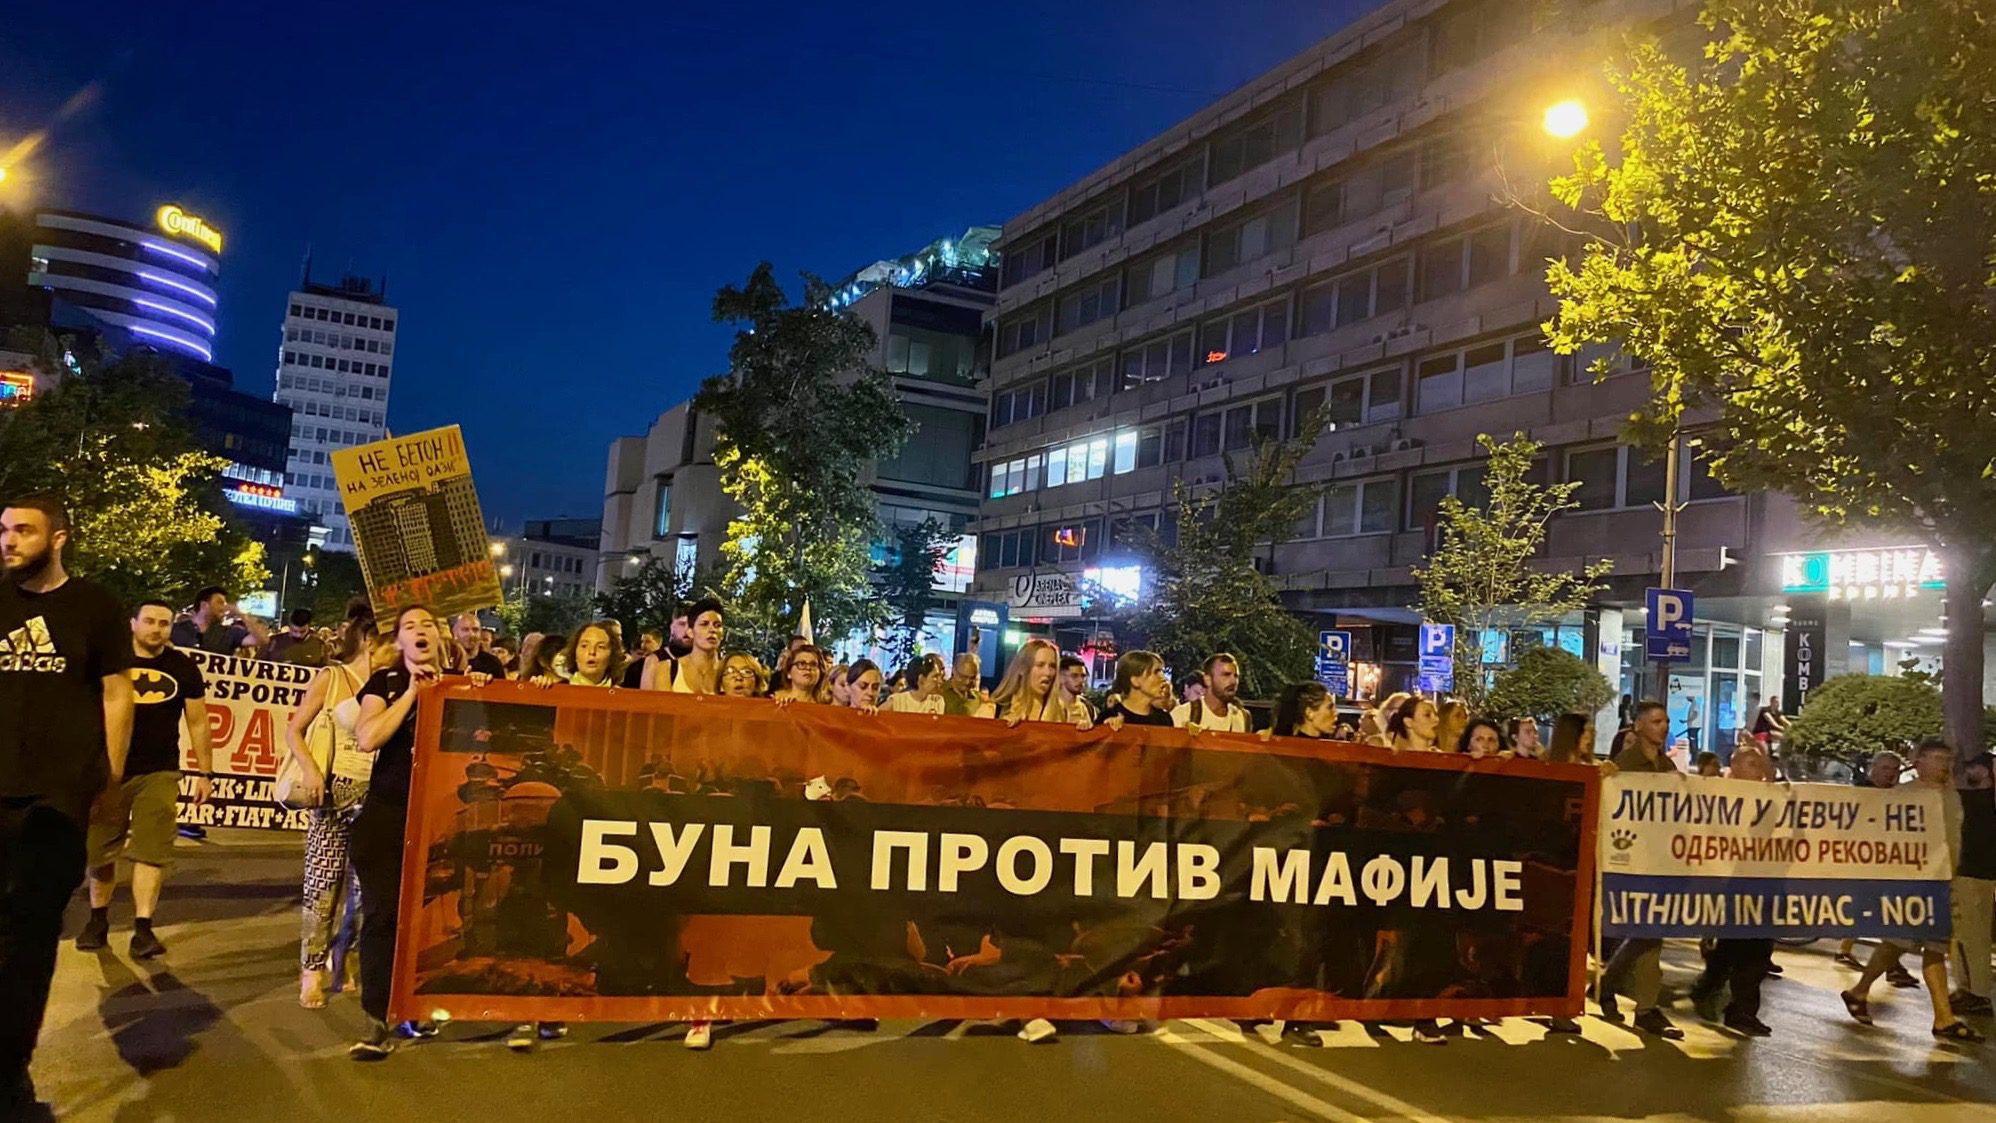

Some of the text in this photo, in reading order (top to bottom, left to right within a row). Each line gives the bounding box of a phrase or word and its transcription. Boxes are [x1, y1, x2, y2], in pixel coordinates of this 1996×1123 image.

[359, 450, 389, 474] НЕ
[347, 481, 366, 494] НА
[370, 469, 420, 488] ЗЕЛЕНОЈ
[1657, 594, 1683, 631] P
[1326, 635, 1343, 658] P
[1427, 629, 1446, 653] P
[189, 652, 320, 684] PRIVRED
[1797, 633, 1812, 715] KOMBI
[224, 805, 275, 828] FIAT
[1612, 789, 1744, 826] ЛИТИЈУМ
[1750, 799, 1773, 827] У
[1775, 800, 1860, 830] ЛЕВЧУ
[1885, 803, 1927, 832] НЕ!
[576, 819, 1524, 911] БУНА ПРОТИВ МАФИЈЕ
[1671, 834, 1928, 870] ОДБРАНИМО РЕКОВАЦ!
[1608, 891, 1727, 926] LITHIUM
[1735, 894, 1763, 926] IN
[1772, 894, 1855, 927] LEVAC
[1880, 895, 1935, 927] NO!
